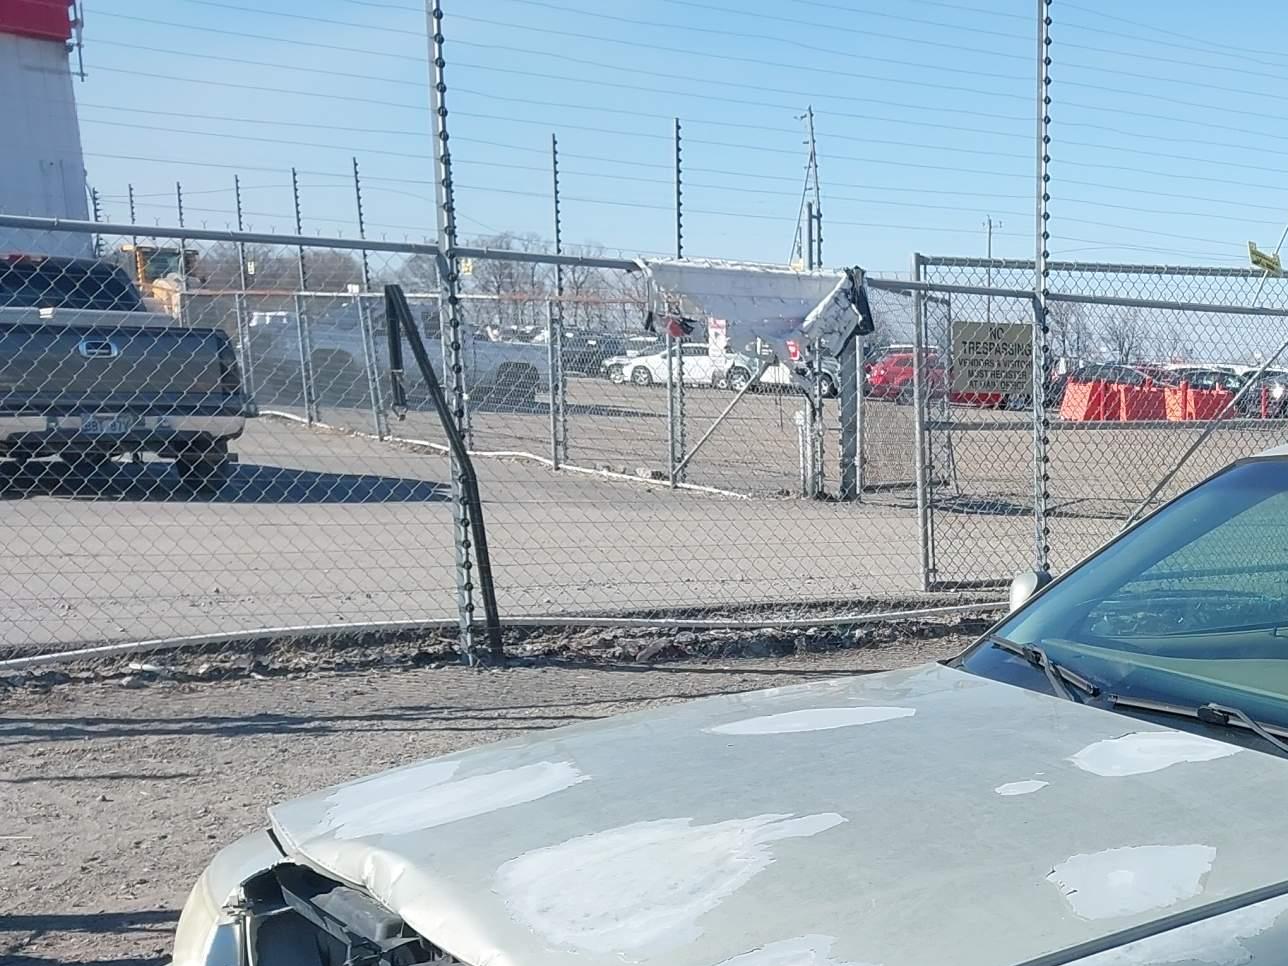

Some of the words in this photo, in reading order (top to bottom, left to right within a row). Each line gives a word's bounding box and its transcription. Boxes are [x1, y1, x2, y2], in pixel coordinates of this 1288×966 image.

[989, 327, 1004, 340] NO
[962, 341, 1032, 356] TRESPASSING
[958, 358, 994, 368] VENDORS
[1003, 359, 1033, 369] VISITOR
[968, 369, 989, 378] MUST
[990, 370, 1027, 380] REGISTER
